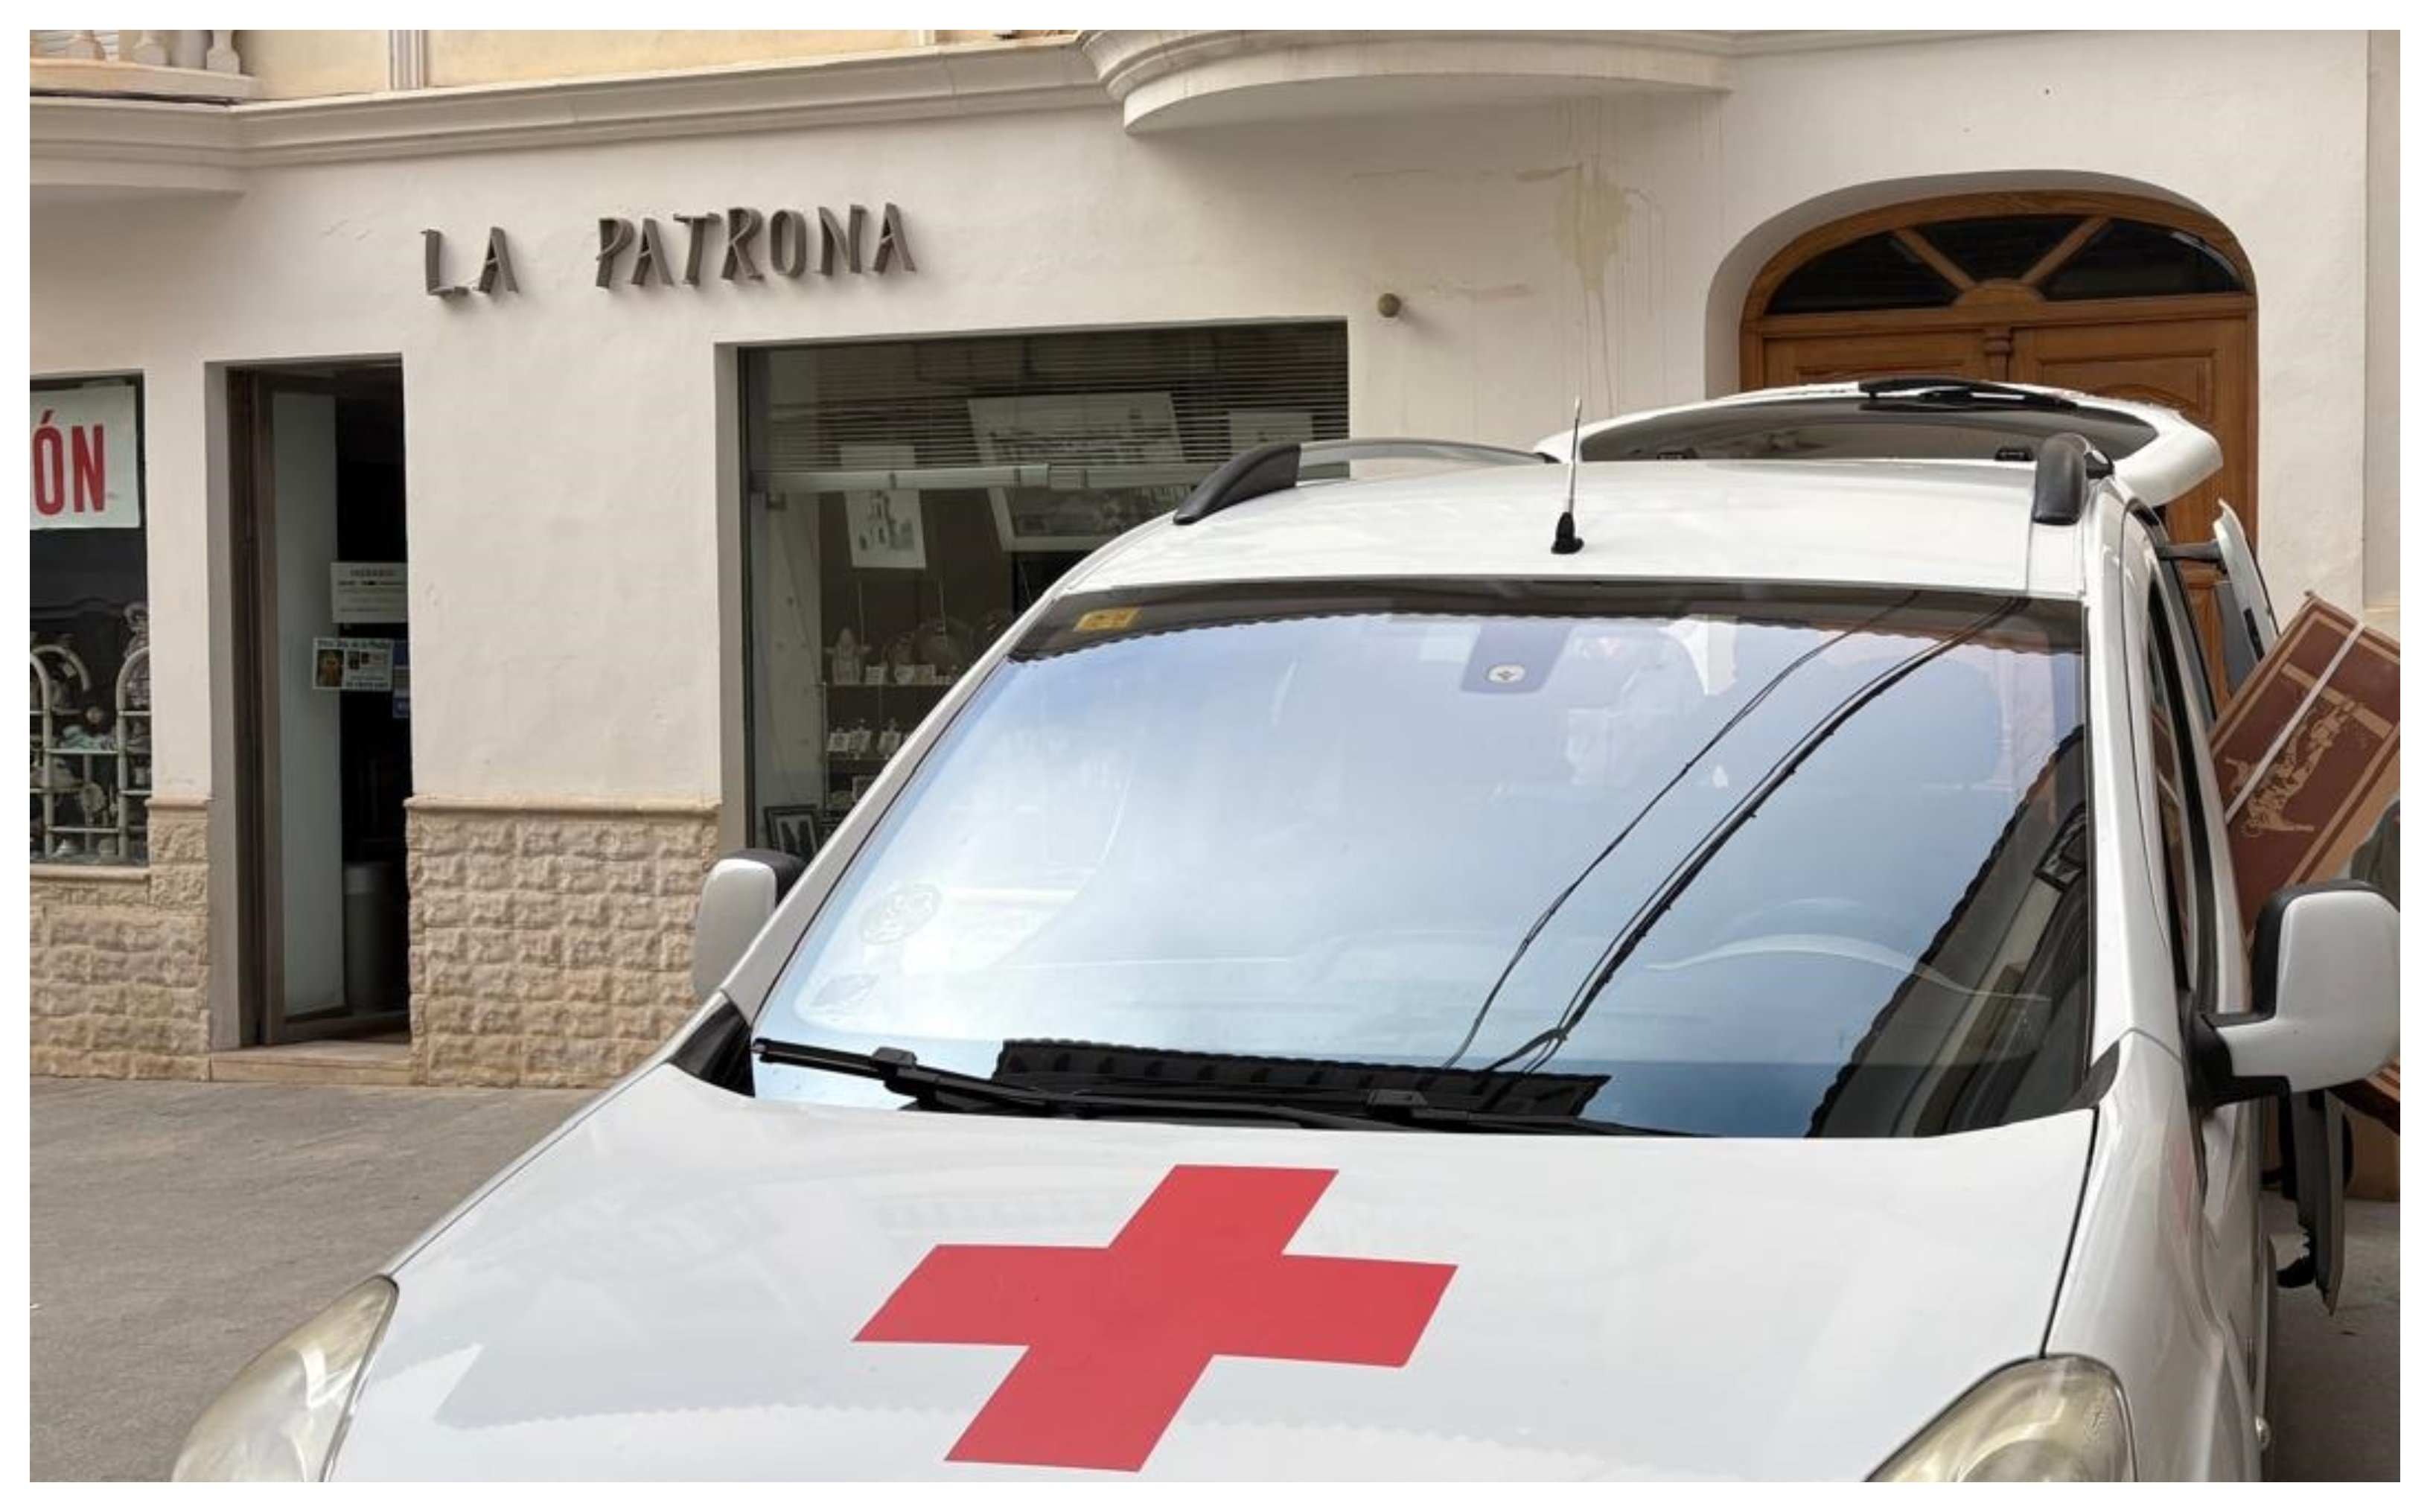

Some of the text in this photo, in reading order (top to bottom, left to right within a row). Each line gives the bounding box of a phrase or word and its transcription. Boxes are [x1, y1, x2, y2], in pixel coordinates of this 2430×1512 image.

[421, 202, 916, 296] LA PATRONA
[33, 409, 104, 515] ÓN
